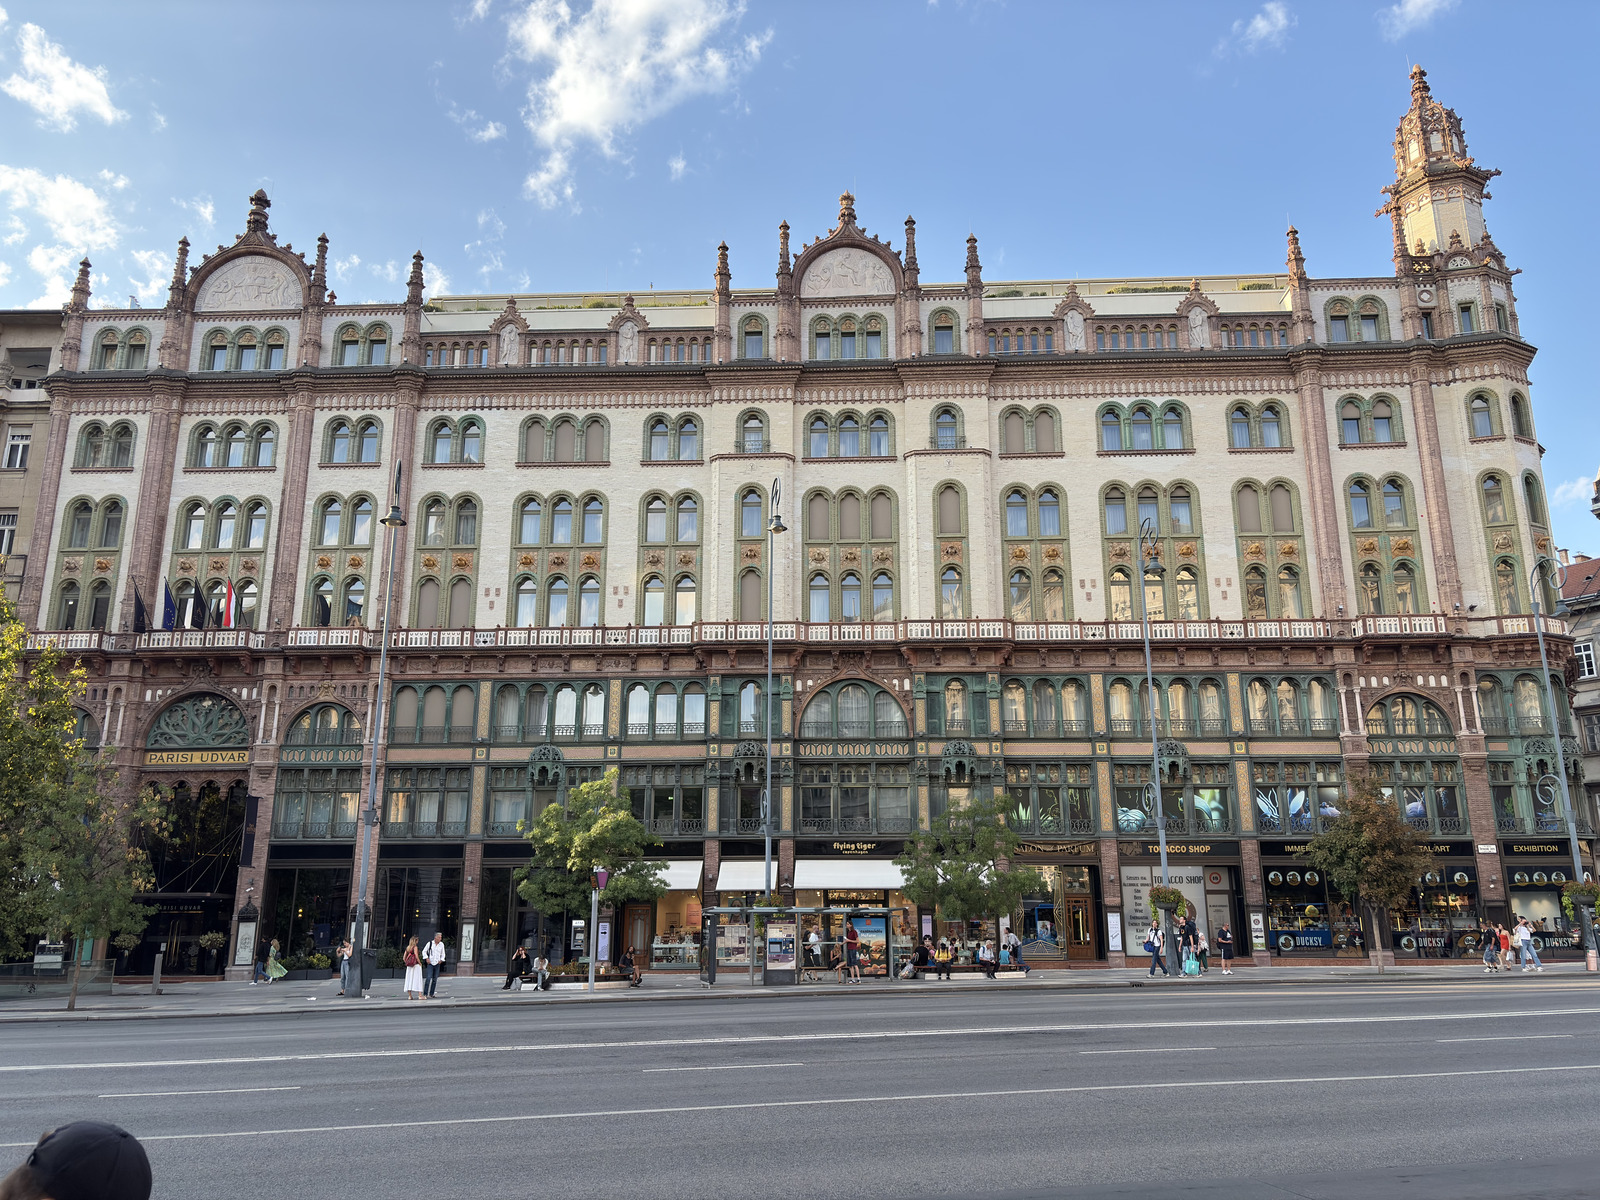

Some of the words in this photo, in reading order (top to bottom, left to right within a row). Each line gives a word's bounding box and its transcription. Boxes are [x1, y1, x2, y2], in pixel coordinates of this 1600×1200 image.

[200, 752, 246, 762] UDVAR
[833, 842, 855, 850] flying
[856, 842, 876, 850] tiger
[1013, 844, 1043, 853] SALON
[1057, 844, 1094, 853] PARFUM
[1148, 845, 1186, 853] TOACCO
[1189, 845, 1211, 853] SHOP
[1153, 875, 1183, 884] TOACCO
[1186, 875, 1204, 884] SHOP
[1295, 936, 1322, 946] DUCKSY
[1418, 937, 1445, 947] DUCKSY
[1545, 937, 1572, 947] DUCKSY
